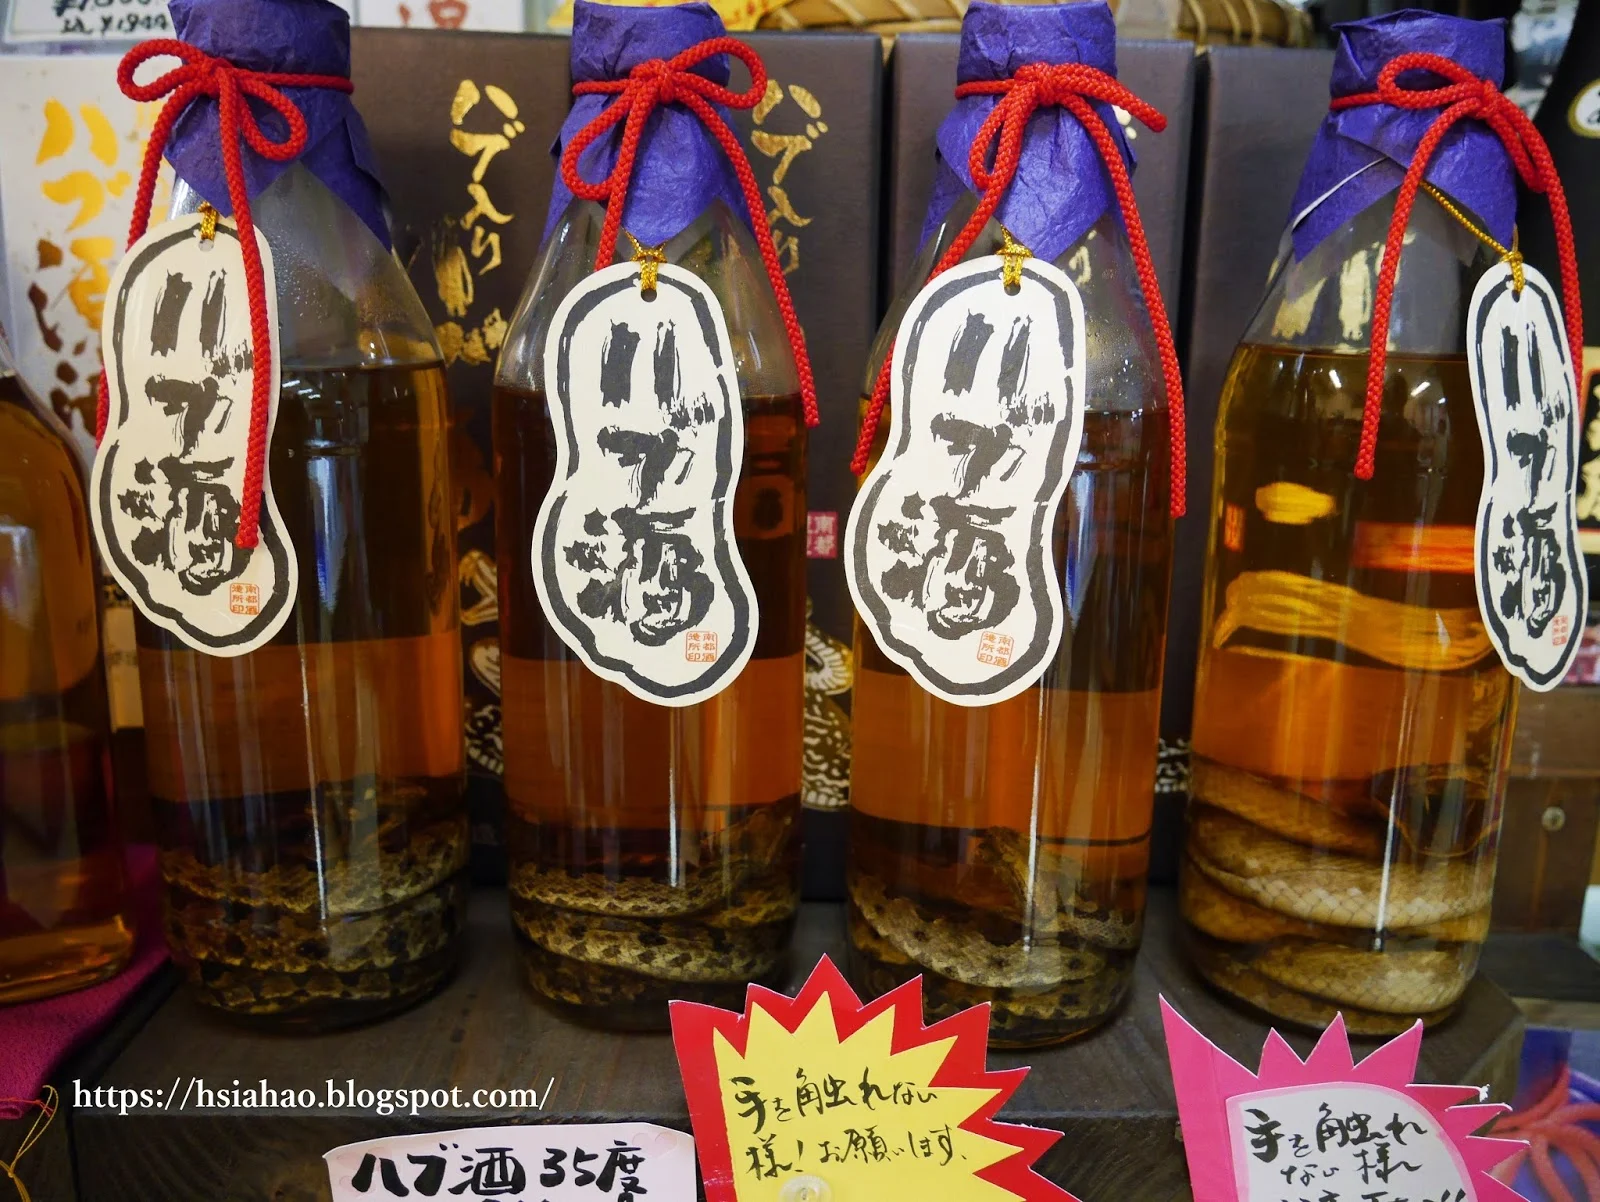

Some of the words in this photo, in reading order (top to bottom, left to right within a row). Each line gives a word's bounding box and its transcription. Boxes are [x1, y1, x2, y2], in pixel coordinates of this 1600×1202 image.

[450, 78, 526, 276] ハブ入り
[118, 267, 255, 597] ハブ酒
[563, 319, 716, 647] ハブ酒
[877, 308, 1056, 641] ハブ酒
[1492, 321, 1567, 640] ハブ酒
[351, 1143, 527, 1198] ハブ酒
[539, 1139, 649, 1195] 35度
